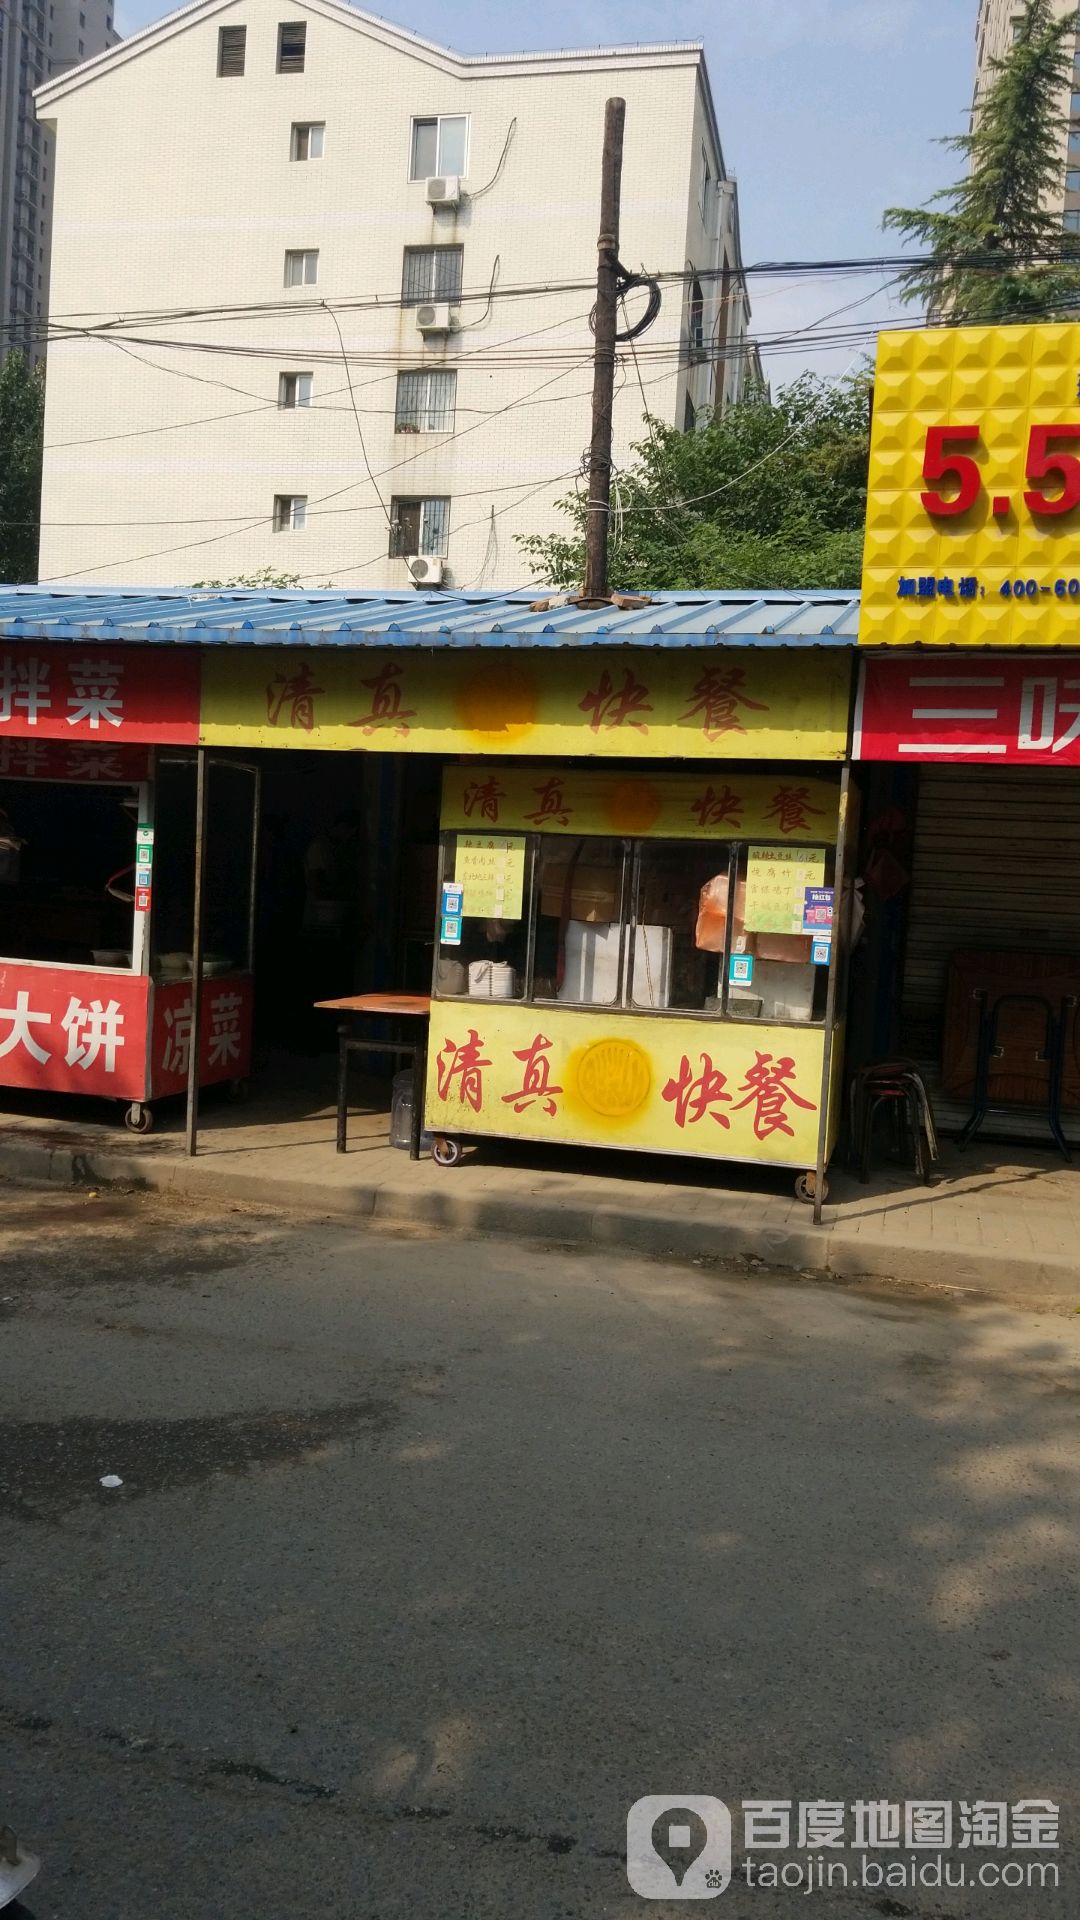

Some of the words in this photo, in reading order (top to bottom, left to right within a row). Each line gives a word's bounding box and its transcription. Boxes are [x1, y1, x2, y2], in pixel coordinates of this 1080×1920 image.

[920, 424, 1080, 518] 5.5
[266, 663, 417, 738] 清真
[578, 666, 770, 741] 快餐
[463, 776, 573, 827] 清真
[691, 784, 826, 833] 快餐
[0, 991, 125, 1072] 大饼
[436, 1029, 564, 1117] 清真
[662, 1050, 818, 1140] 快餐
